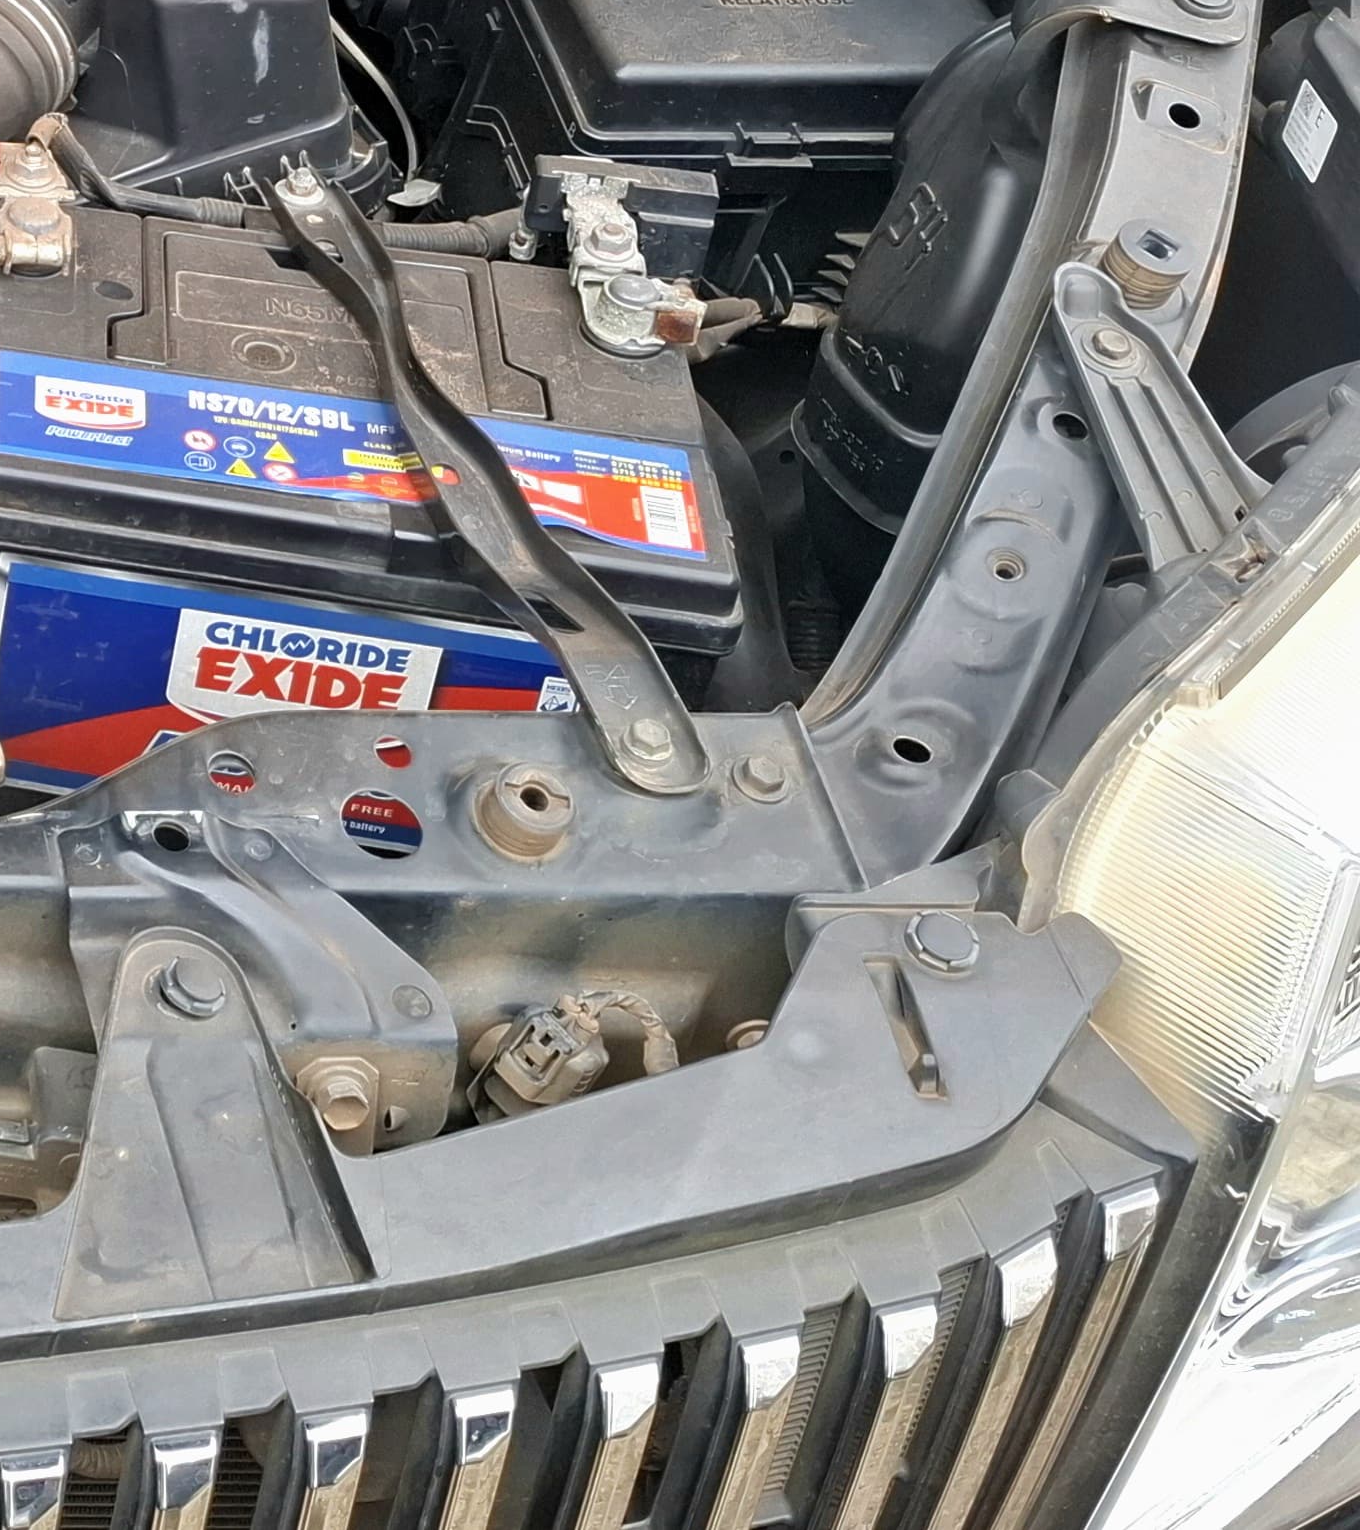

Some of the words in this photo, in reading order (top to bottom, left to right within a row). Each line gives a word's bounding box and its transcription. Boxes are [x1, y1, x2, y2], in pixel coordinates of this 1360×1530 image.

[45, 396, 134, 418] EXIDE
[189, 390, 355, 432] NS70/12/SBL
[205, 621, 412, 673] CHLORIDE
[195, 648, 407, 710] EXIDE
[350, 803, 393, 818] FREE
